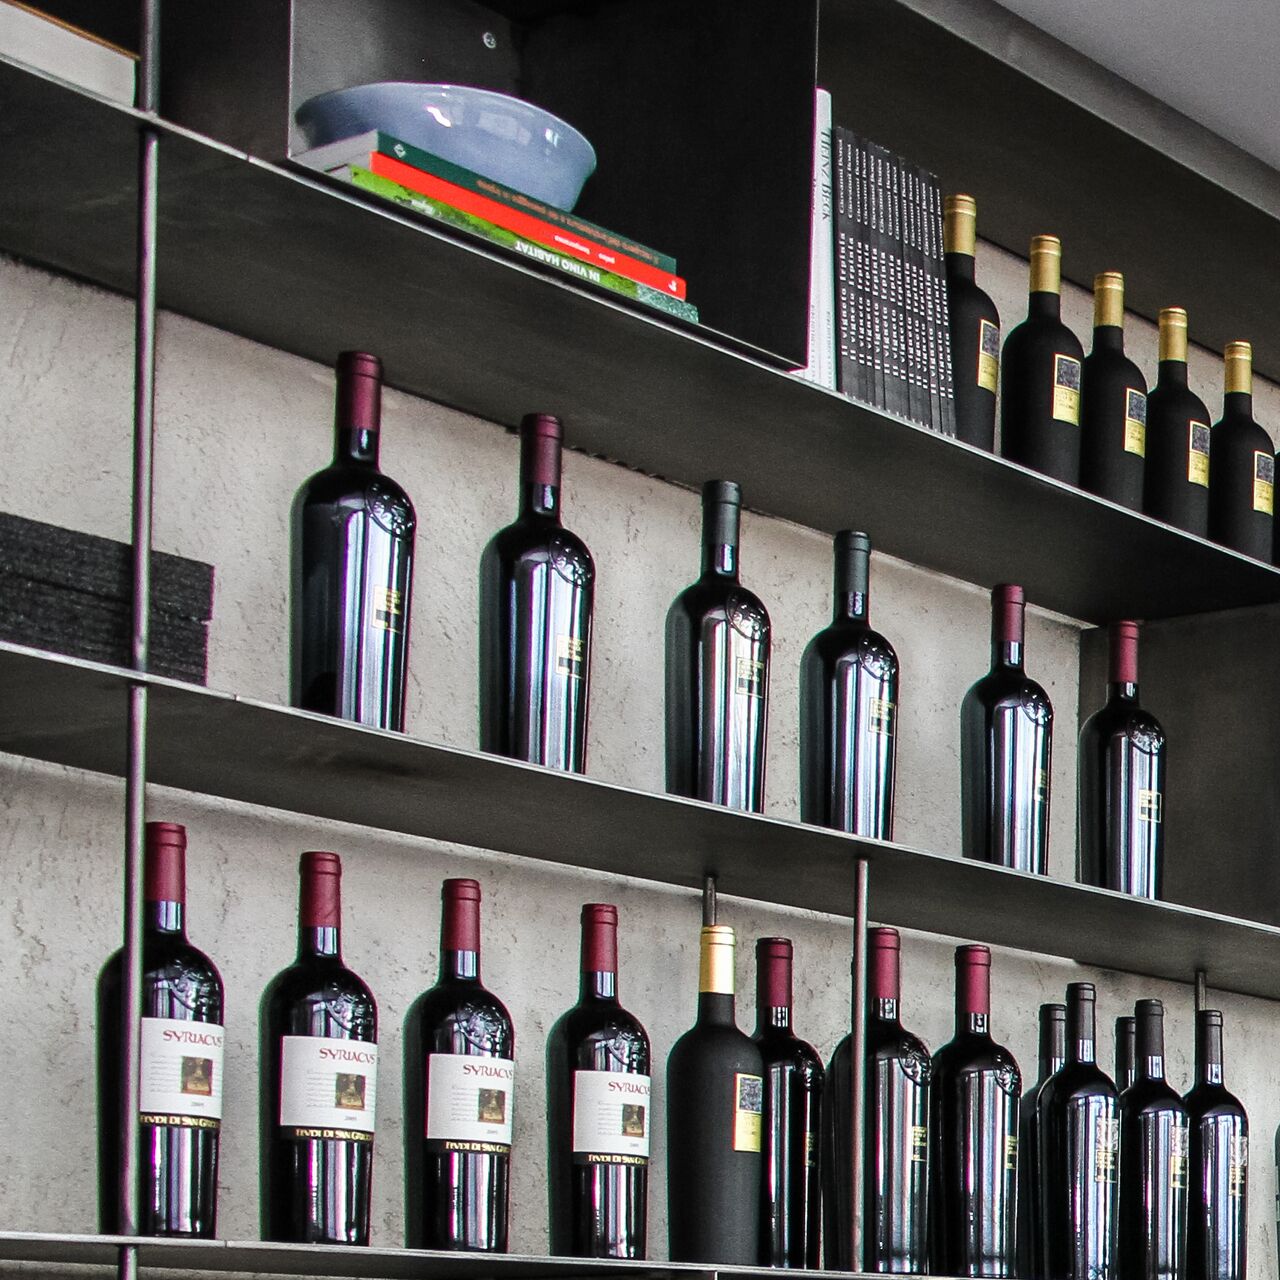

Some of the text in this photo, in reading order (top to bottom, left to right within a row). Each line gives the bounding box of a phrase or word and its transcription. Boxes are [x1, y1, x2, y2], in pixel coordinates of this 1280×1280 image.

[514, 240, 560, 267] HABITAT
[561, 260, 588, 277] VINO
[588, 270, 600, 283] IN
